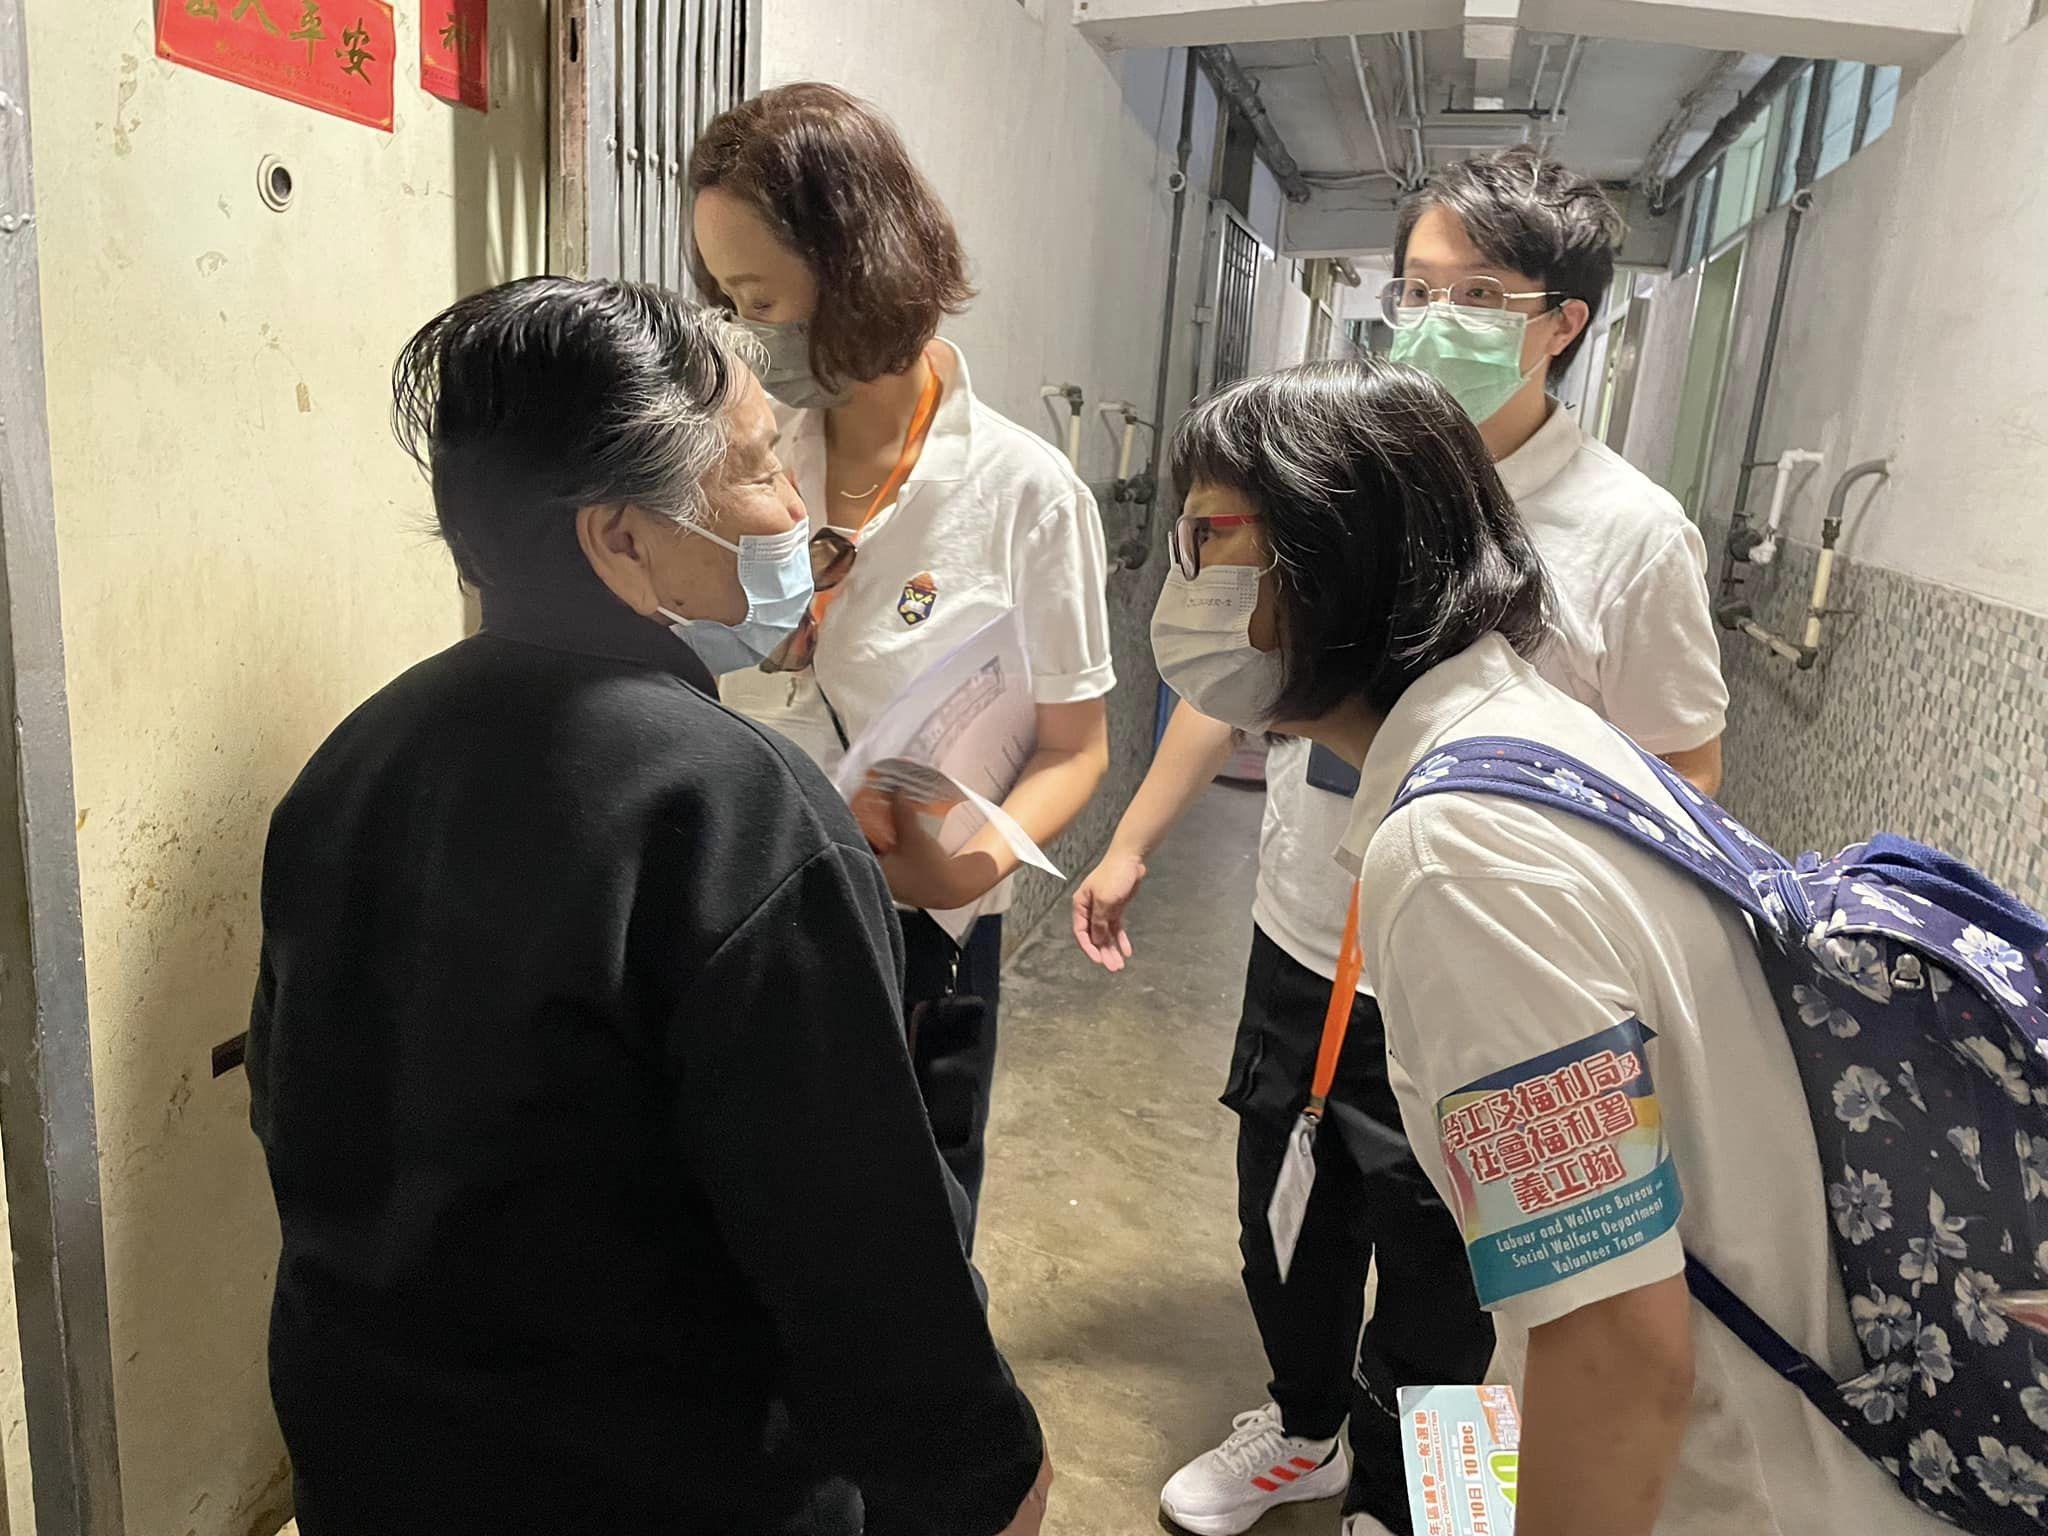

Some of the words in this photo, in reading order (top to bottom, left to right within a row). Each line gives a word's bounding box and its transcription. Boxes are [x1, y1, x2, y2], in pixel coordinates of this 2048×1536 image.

[1469, 1091, 1637, 1183] 社會福利署
[1511, 1145, 1626, 1213] 義工隊
[1496, 1228, 1536, 1252] Labour
[1540, 1221, 1563, 1239] and
[1564, 1202, 1612, 1229] Welfare
[1614, 1183, 1653, 1210] Bureau
[1511, 1245, 1549, 1268] Social
[1551, 1230, 1600, 1256] Welfare
[1601, 1197, 1664, 1237] Department
[1552, 1243, 1611, 1275] Volunteer
[1614, 1229, 1644, 1251] Team
[1461, 1425, 1476, 1455] Dec
[1464, 1459, 1479, 1476] 10
